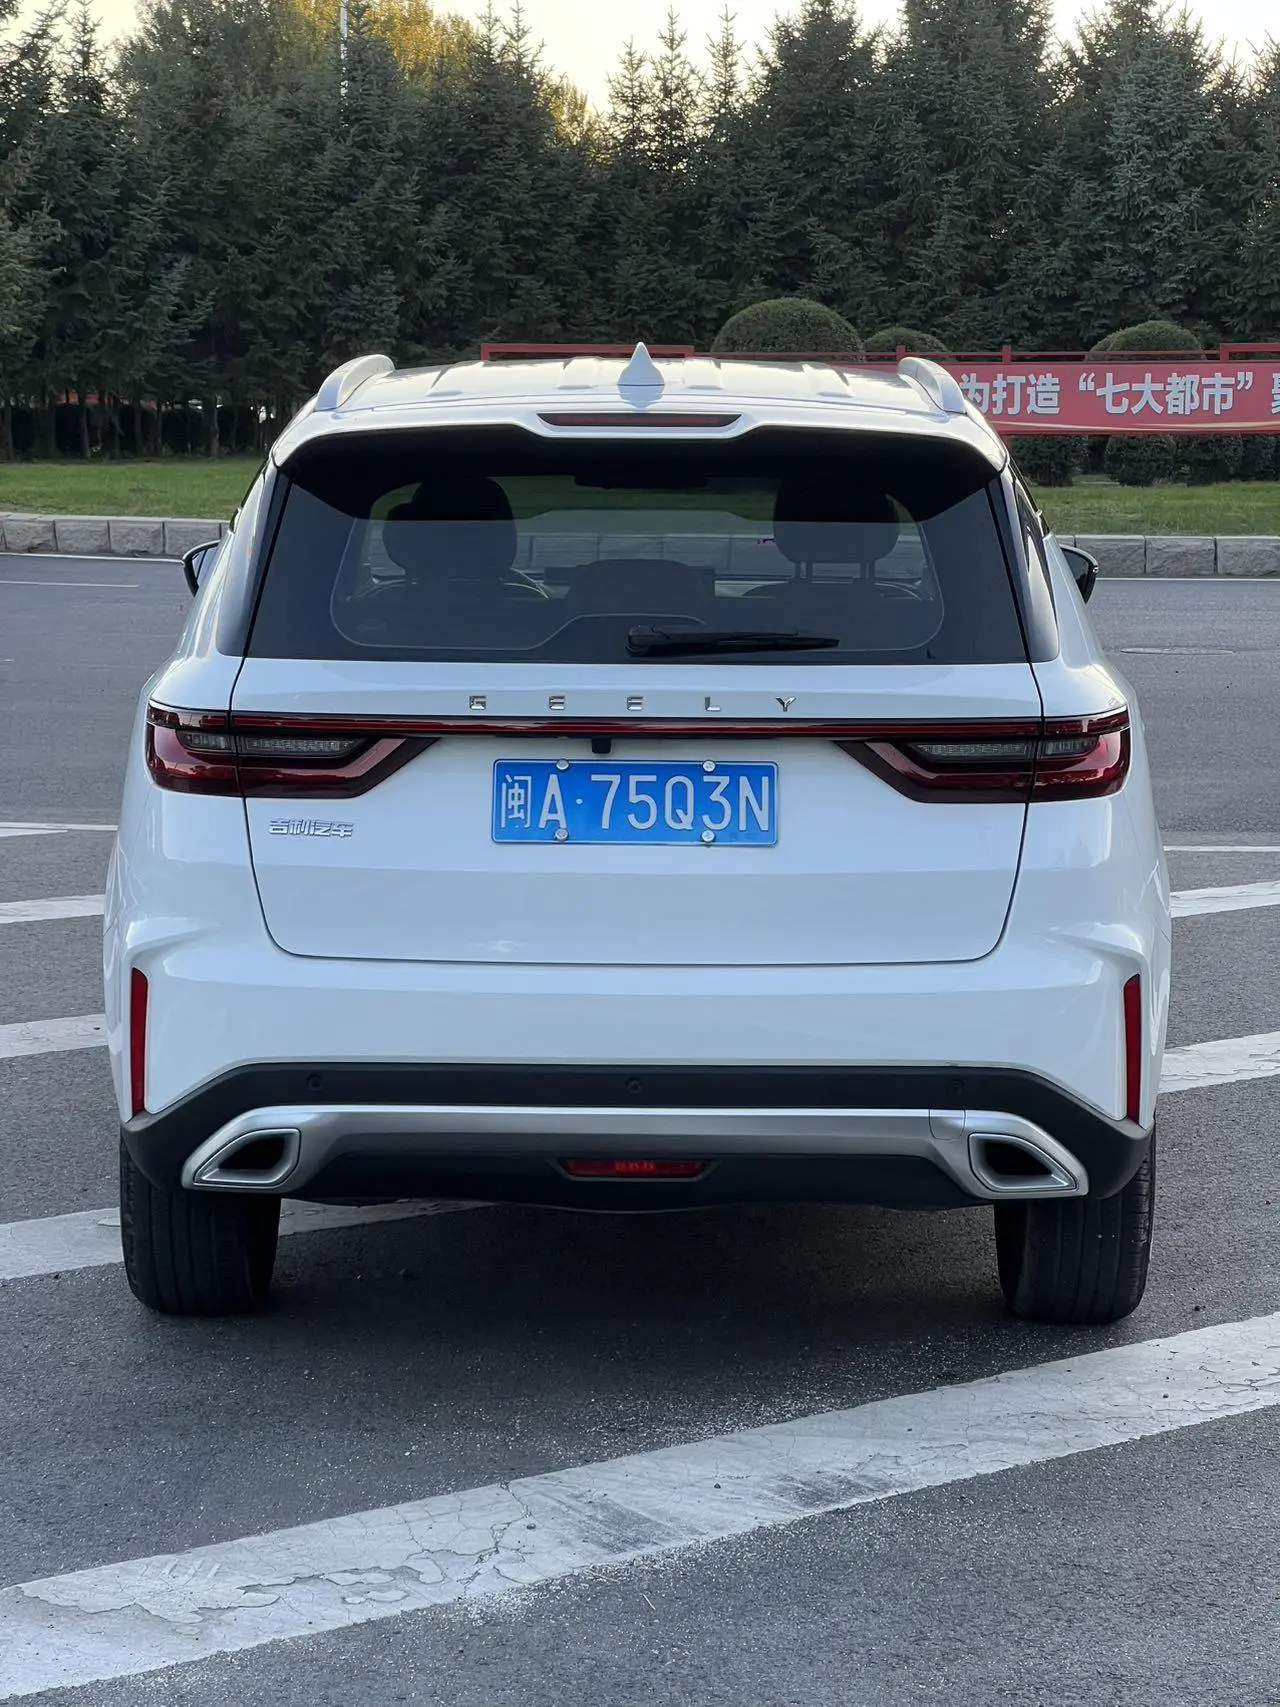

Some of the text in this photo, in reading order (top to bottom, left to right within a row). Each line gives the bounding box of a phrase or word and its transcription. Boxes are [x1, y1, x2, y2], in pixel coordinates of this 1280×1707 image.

[959, 371, 1280, 415] 为打造“七大都市”
[469, 695, 797, 712] GEELY
[269, 819, 354, 837] 吉利汽车
